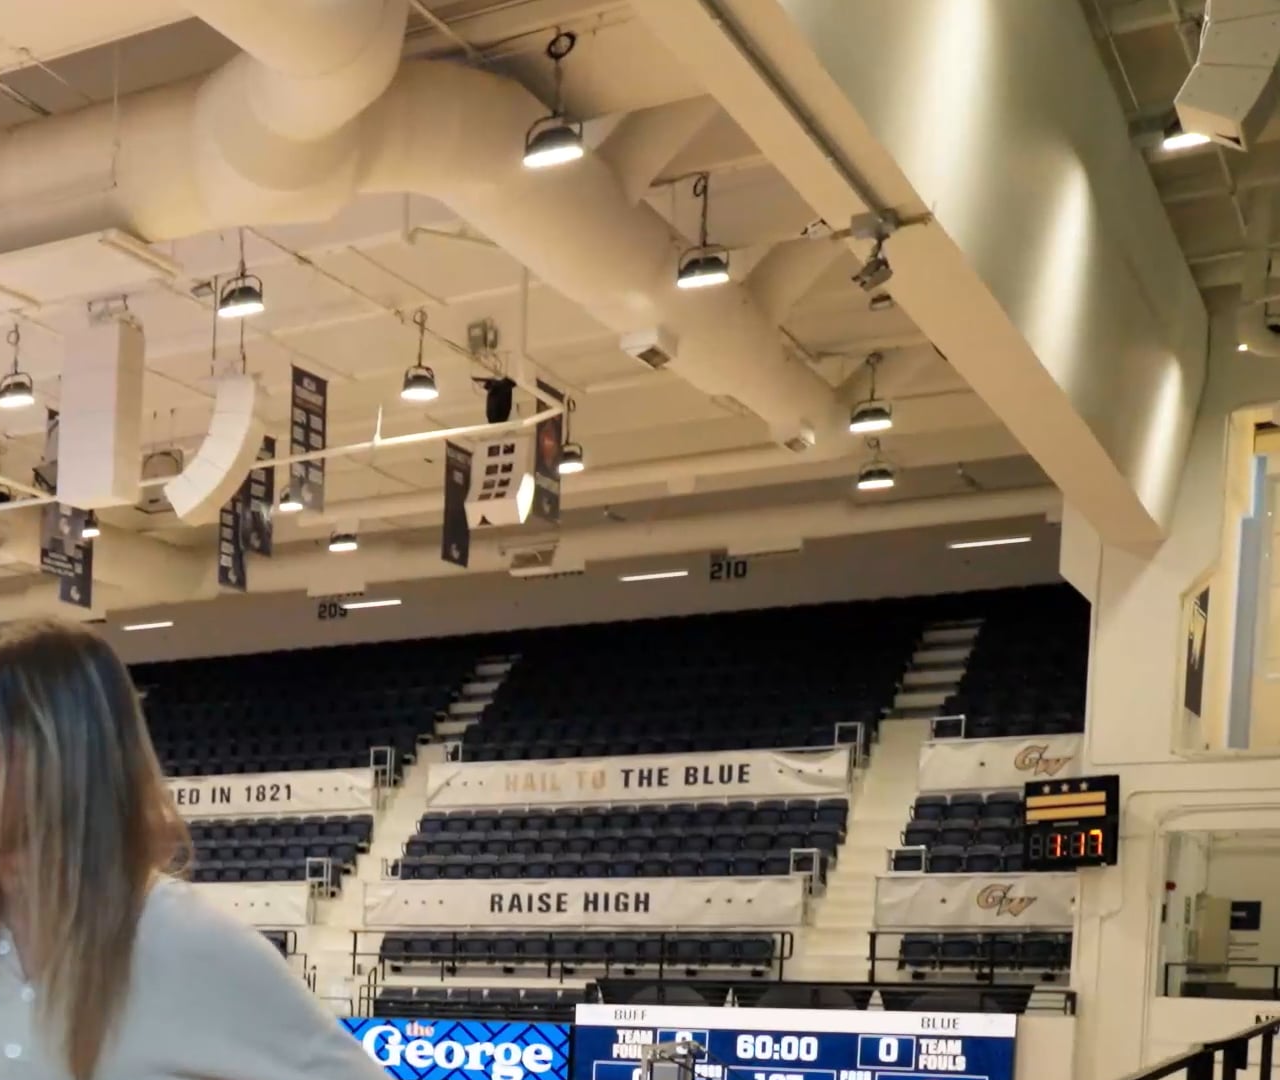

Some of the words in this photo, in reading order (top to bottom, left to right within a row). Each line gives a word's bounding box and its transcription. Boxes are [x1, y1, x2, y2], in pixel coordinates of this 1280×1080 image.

[710, 561, 748, 579] 210
[504, 769, 562, 792] HAIL
[576, 769, 608, 791] TO
[620, 767, 669, 789] THE
[684, 764, 751, 786] BLUE
[211, 787, 231, 804] IN
[245, 784, 292, 802] 1821
[489, 892, 568, 914] RAISE
[583, 891, 651, 913] HIGH
[614, 1009, 648, 1021] BUFF
[920, 1016, 961, 1030] BLUE
[405, 1021, 435, 1037] the
[616, 1029, 653, 1045] TEAM
[736, 1034, 818, 1062] 60:00
[878, 1037, 899, 1062] 0
[919, 1038, 962, 1055] TEAM
[918, 1055, 967, 1071] FOULS
